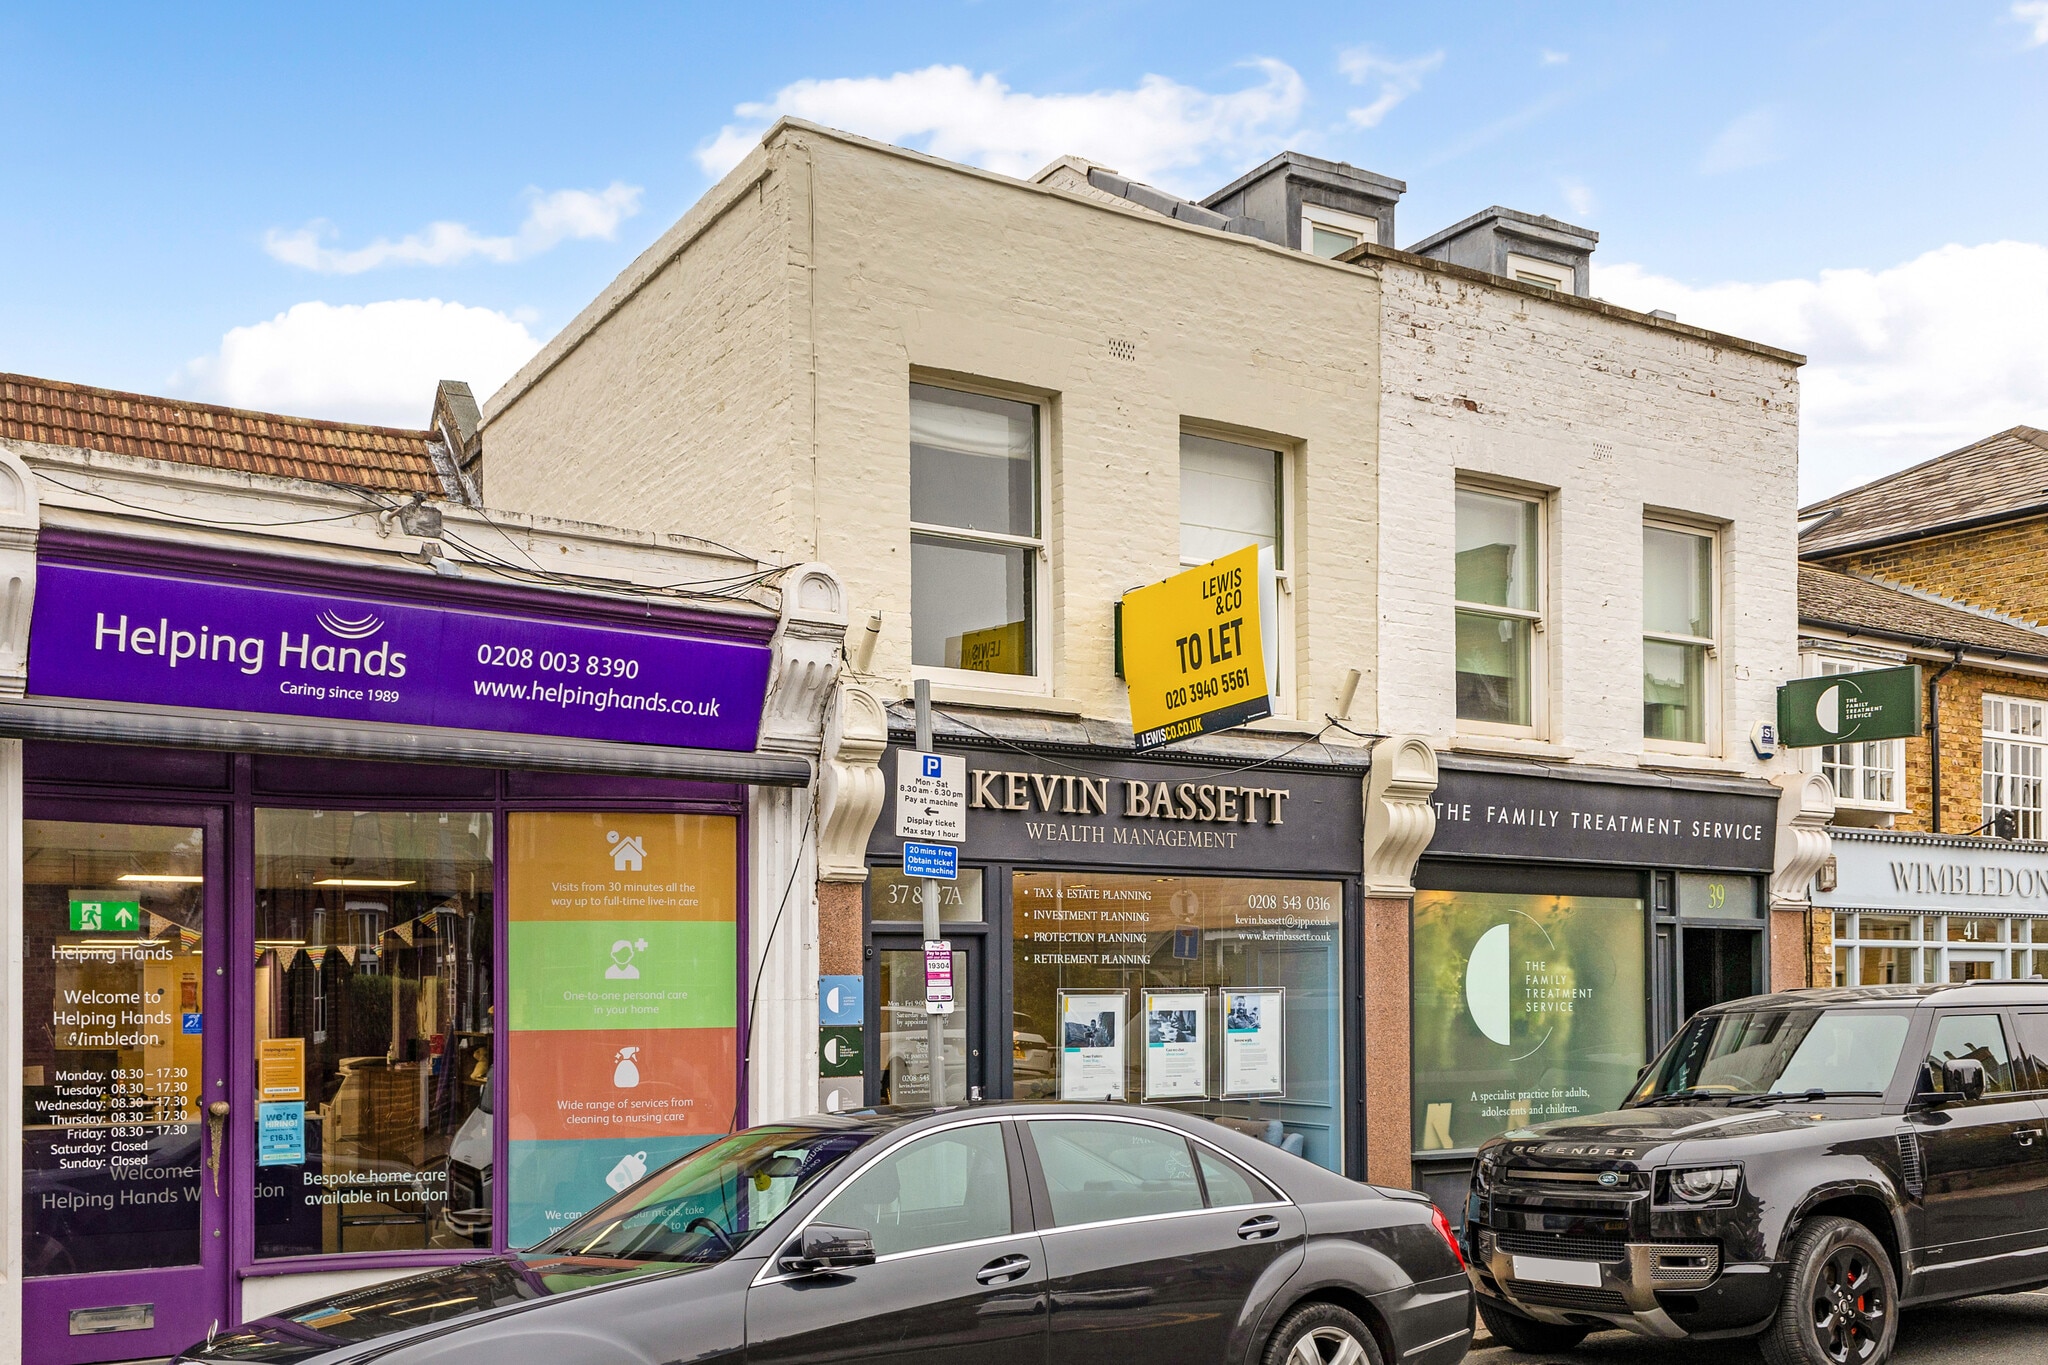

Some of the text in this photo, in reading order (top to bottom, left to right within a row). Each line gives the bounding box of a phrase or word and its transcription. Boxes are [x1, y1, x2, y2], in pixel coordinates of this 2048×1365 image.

[1203, 567, 1242, 600] LEWIS
[1215, 589, 1242, 616] &CO
[95, 612, 407, 679] Helping Hands
[1176, 617, 1243, 674] TO LET
[477, 644, 639, 679] 0208 003 8390
[280, 681, 400, 703] Caring since 1989
[1165, 667, 1250, 710] 020 3940 5561
[474, 678, 720, 718] www.helpinghands.co.uk
[1846, 706, 1883, 714] TREATMENT
[1846, 712, 1872, 720] SERVICE
[1141, 718, 1203, 747] LEWISCO.CO.UK
[927, 758, 939, 775] P
[916, 778, 948, 788] Mon Sat
[899, 785, 917, 793] 8.30
[934, 788, 951, 797] 6.30
[953, 791, 963, 799] pm
[969, 769, 1290, 825] KEVIN BASSETT
[905, 795, 918, 804] Pay
[929, 798, 958, 807] machine
[907, 816, 956, 828] Display ticket
[1435, 802, 1762, 841] THE FAMILY TREATMENT SERVICE
[903, 826, 918, 834] Max
[920, 828, 935, 837] stay
[943, 830, 959, 838] hour
[1025, 822, 1238, 849] WEALTH MANAGEMENT
[909, 846, 952, 857] 20 mins free
[908, 856, 954, 867] Obtain ticket
[907, 864, 954, 875] from machine
[1890, 861, 2048, 898] WIMBLEDON
[552, 882, 696, 893] Visits from 30 minutes all the
[887, 884, 909, 904] 37
[1034, 888, 1151, 900] TAX & ESTATE PLANNING
[551, 896, 698, 908] way up to full-time live-in care
[1248, 894, 1331, 911] 0208 543 0316
[1708, 884, 1725, 909] 39
[1034, 910, 1150, 922] INVESTMENT PLANNING
[1235, 914, 1331, 929] kevin.bassett@sjpp.co.uk
[1034, 932, 1147, 943] PROTECTION PLANNING
[1238, 931, 1331, 941] www.kevinbassett.co.uk
[1963, 921, 1979, 940] 41
[51, 945, 173, 963] Helping Hands
[1034, 954, 1151, 964] RETIREMENT PLANNING
[1525, 961, 1546, 971] THE
[1525, 975, 1567, 985] FAMILY
[64, 990, 161, 1004] Welcome to
[563, 991, 688, 1002] One-to-one personal care
[1525, 988, 1593, 999] TREATMENT
[594, 1004, 659, 1016] in your home
[1525, 1002, 1574, 1012] SERVICE
[53, 1011, 171, 1028] Helping Hands
[55, 1068, 187, 1082] Monday: 08.30 17.30
[54, 1082, 187, 1097] Tuesday: 08.30 17.30
[1471, 1086, 1590, 1102] A specialist practice for adults,
[35, 1096, 187, 1111] Wednesday: 08.30 17.30
[557, 1097, 694, 1112] Wide range of services from
[1481, 1104, 1580, 1117] adolescents and children.
[49, 1110, 187, 1126] Thursday: 08.30 17.30
[265, 1120, 298, 1128] HIRING!
[567, 1113, 684, 1126] cleaning to nursing care
[67, 1125, 187, 1140] Friday: 08.30 17.30
[50, 1141, 148, 1155] Saturday: Closed
[1513, 1145, 1635, 1157] DEFENDER
[60, 1155, 148, 1169] Sunday: Closed
[303, 1170, 447, 1188] Bespoke home care
[42, 1192, 114, 1212] Helping
[120, 1188, 178, 1206] Hands
[304, 1188, 448, 1206] available in London
[545, 1206, 705, 1220] We can take
